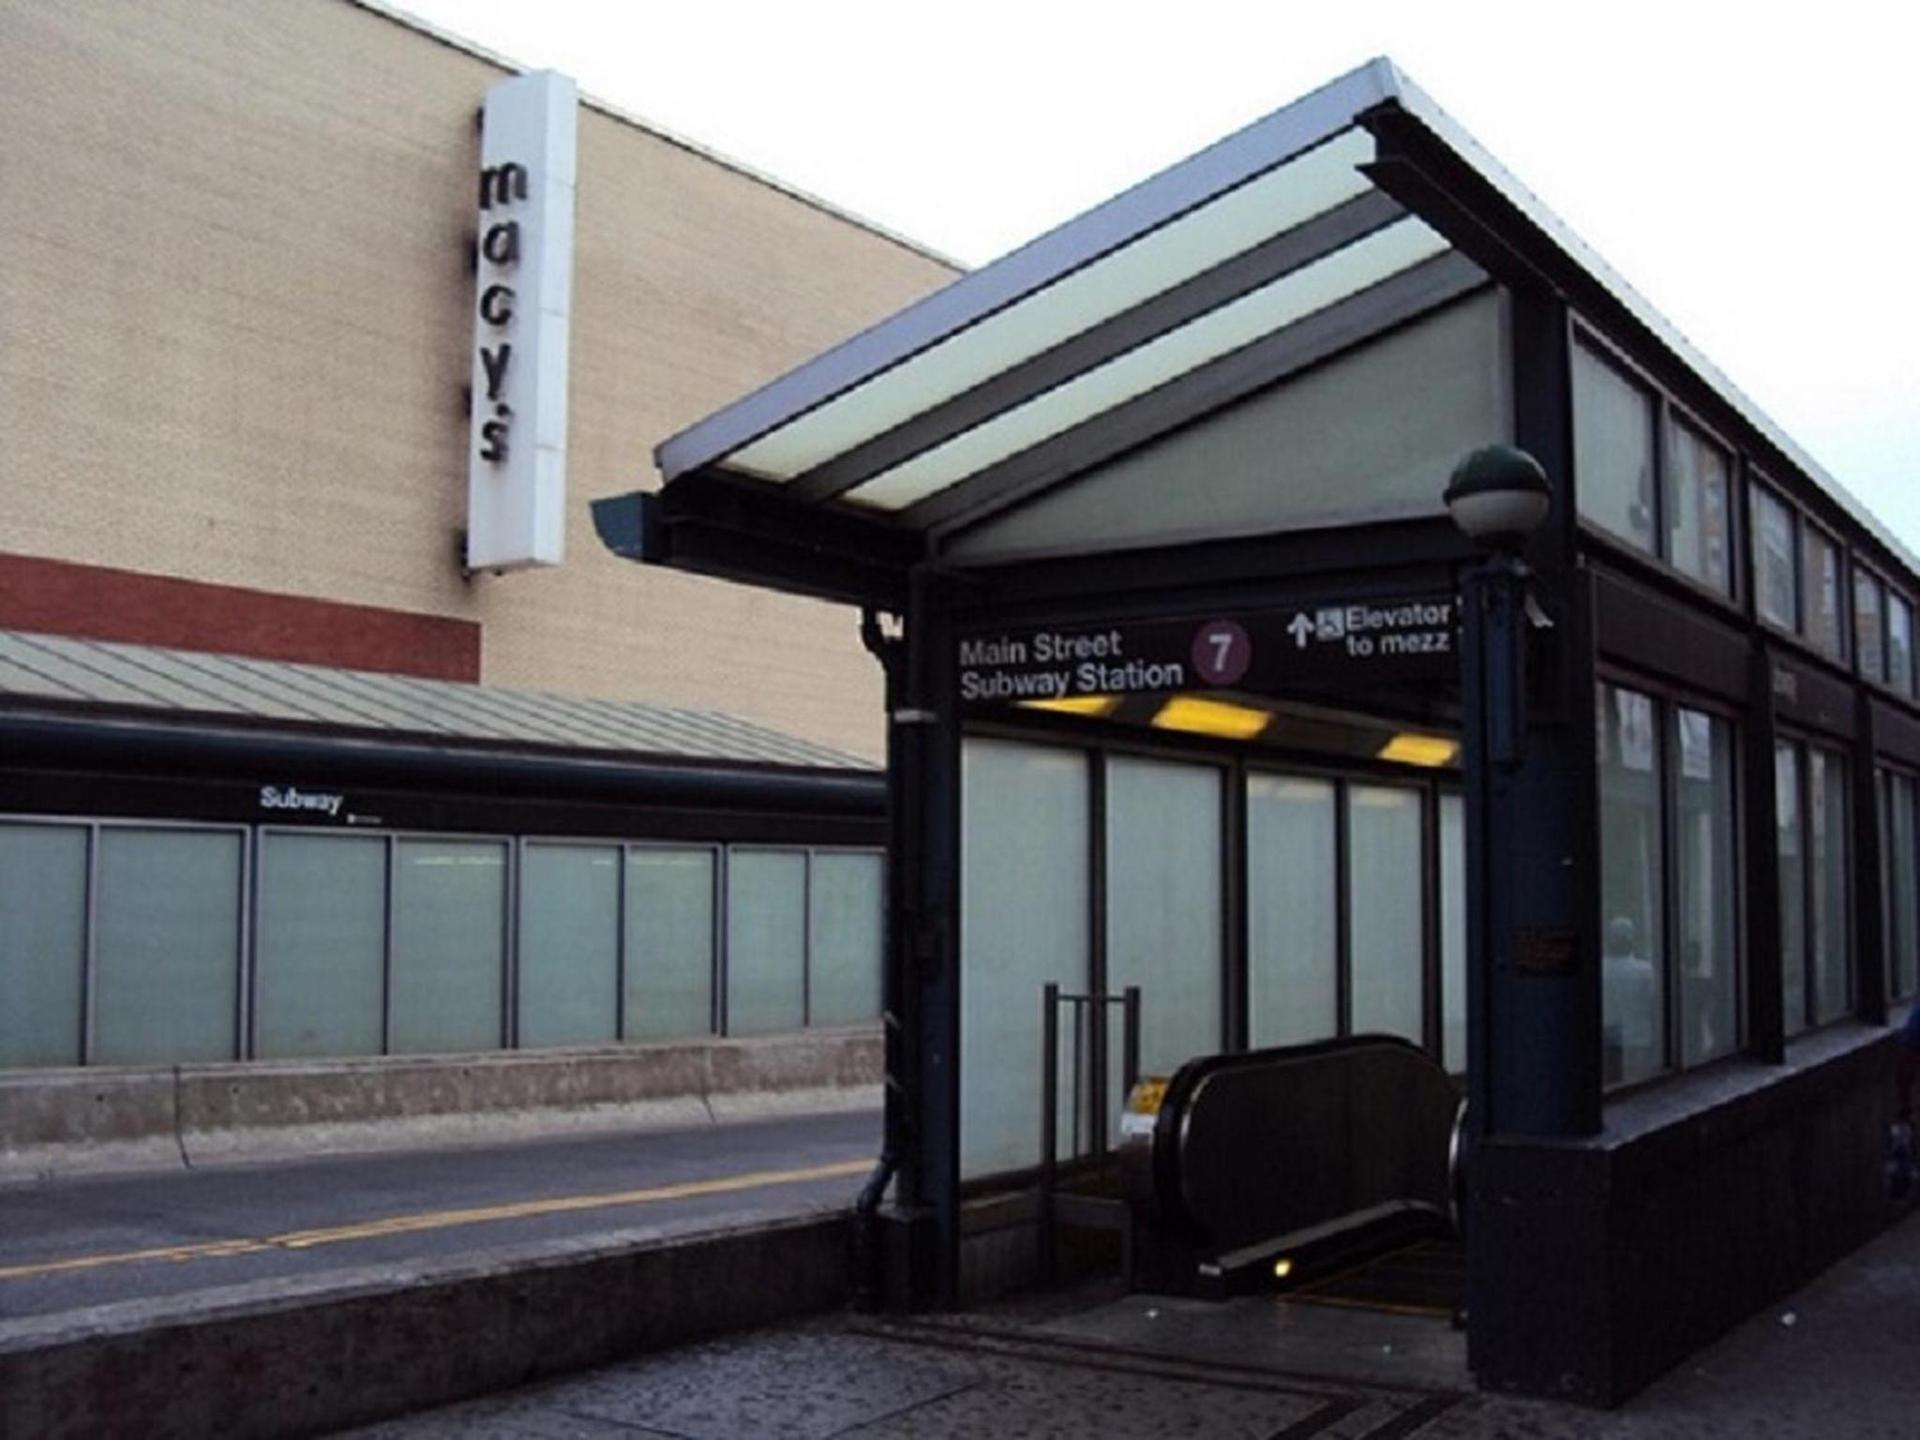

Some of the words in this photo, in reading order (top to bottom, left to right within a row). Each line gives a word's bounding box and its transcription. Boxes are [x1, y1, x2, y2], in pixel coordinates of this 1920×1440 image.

[479, 162, 528, 463] macy's
[1346, 603, 1450, 630] Elevator
[959, 636, 1027, 666] Main
[1033, 630, 1122, 661] Street
[1208, 633, 1232, 672] 7
[1347, 634, 1374, 656] to
[1382, 632, 1450, 654] mezz
[960, 669, 1070, 699] Subway
[1076, 659, 1184, 691] Station
[260, 785, 344, 815] Subway
